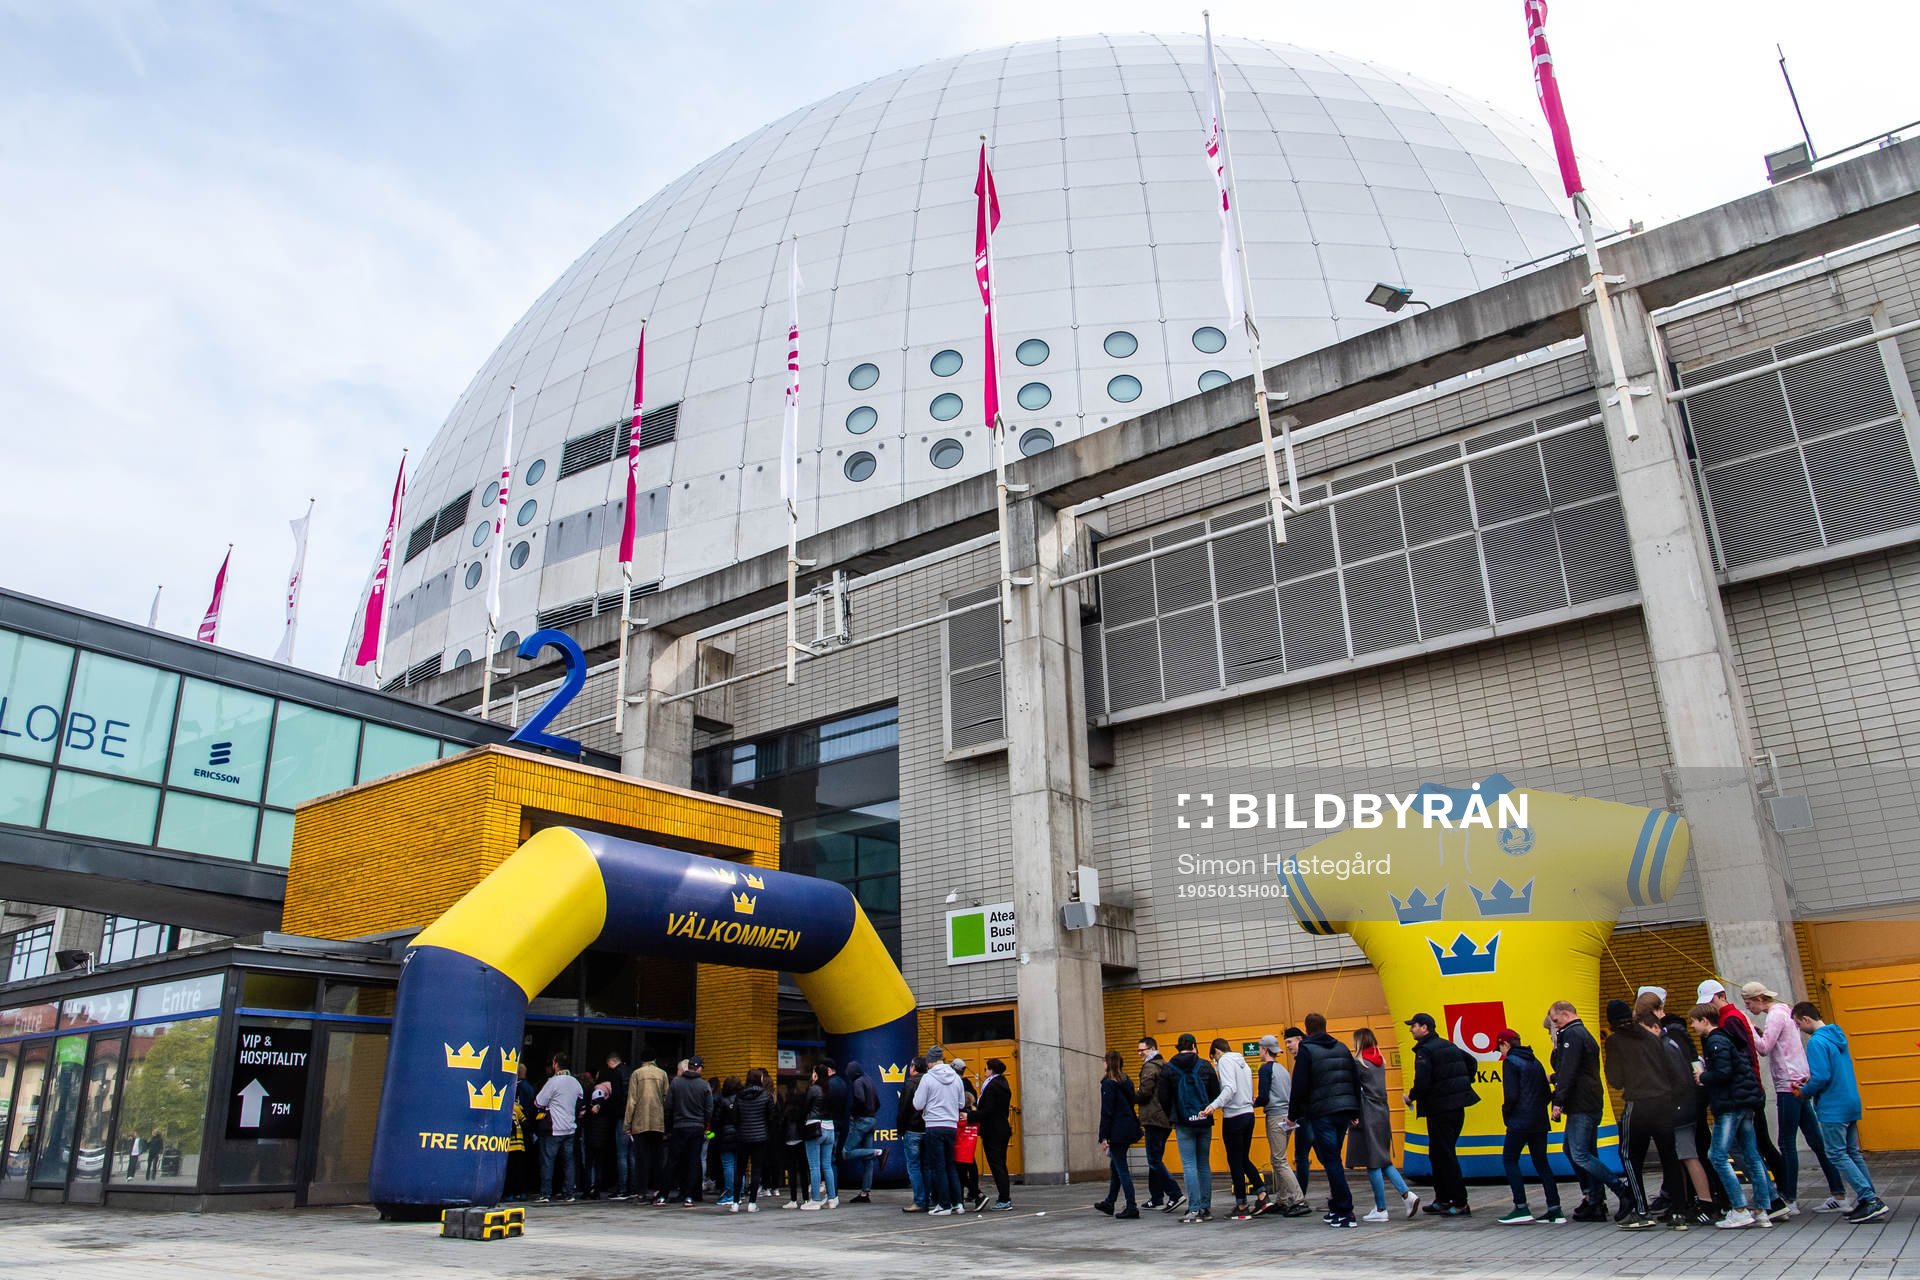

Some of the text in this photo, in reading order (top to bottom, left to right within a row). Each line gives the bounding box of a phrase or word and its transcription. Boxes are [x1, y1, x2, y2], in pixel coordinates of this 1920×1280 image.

[507, 628, 587, 755] 2
[193, 768, 241, 784] ERICSSON
[990, 911, 1015, 924] Atea
[666, 911, 801, 951] VÄLKOMMEN
[990, 924, 1015, 938] Busi
[161, 984, 201, 1013] Entré
[242, 1034, 272, 1048] VIP &
[240, 1050, 307, 1066] HOSPITALITY
[1473, 1070, 1502, 1084] KA
[271, 1103, 291, 1115] 75M
[419, 1132, 459, 1150] TRE
[873, 1129, 898, 1141] TRE
